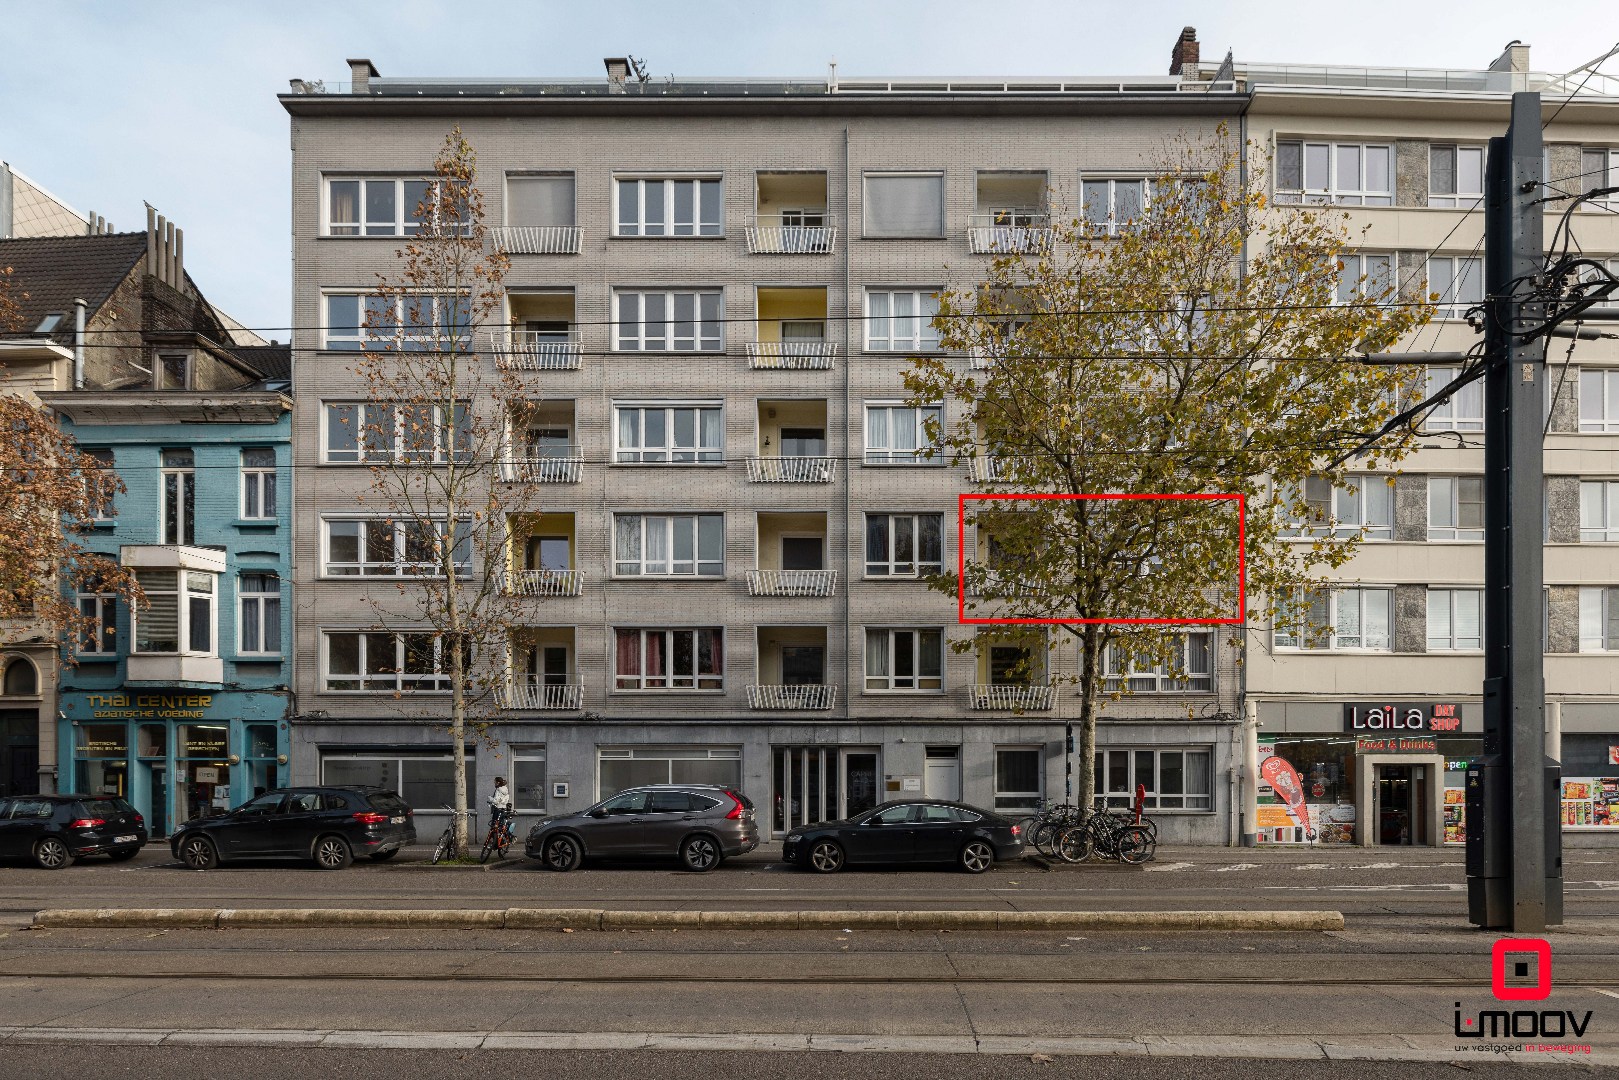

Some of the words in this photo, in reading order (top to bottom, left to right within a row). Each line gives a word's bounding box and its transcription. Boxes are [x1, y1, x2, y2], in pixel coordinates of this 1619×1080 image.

[137, 695, 212, 708] CENTER
[1352, 705, 1423, 729] LaiLa
[1435, 704, 1456, 717] DAY
[1430, 717, 1460, 731] SHOP
[1357, 739, 1385, 751] Food
[1400, 739, 1436, 750] Drinks
[1444, 761, 1468, 770] open
